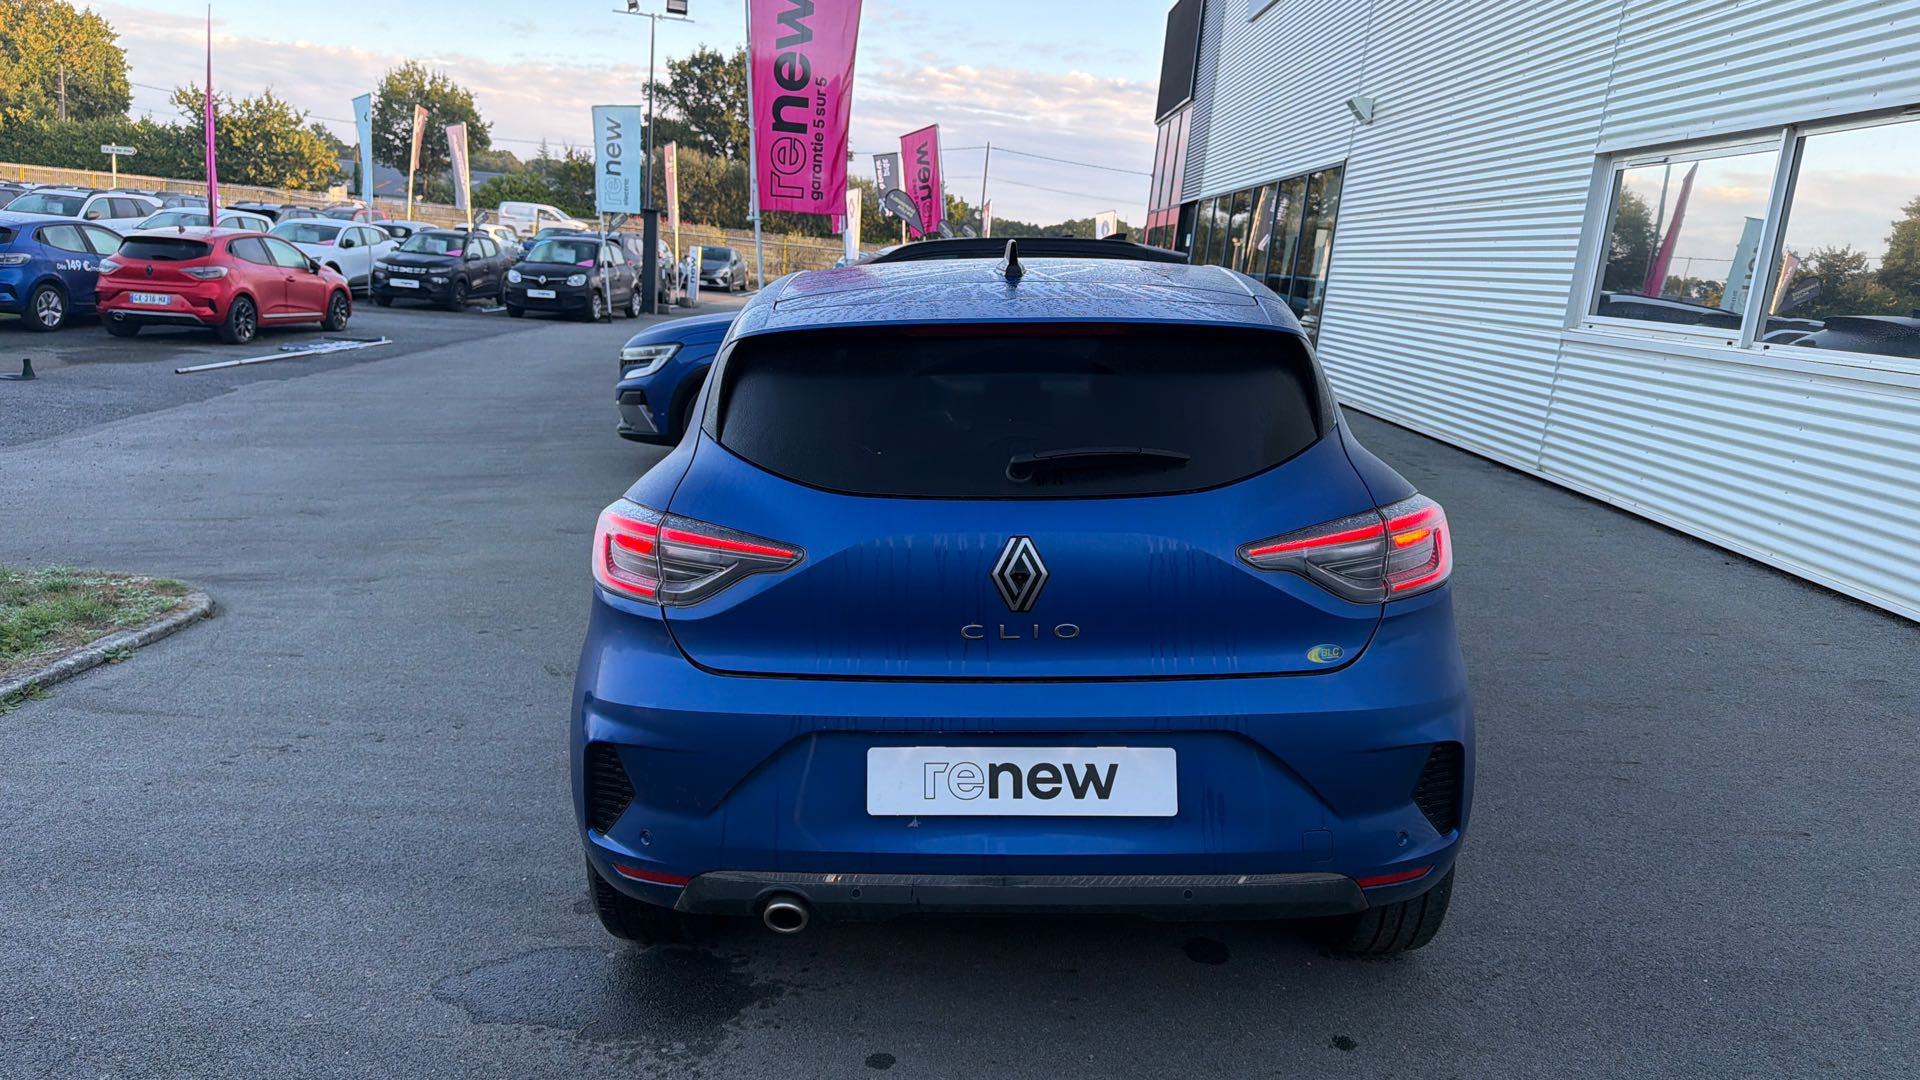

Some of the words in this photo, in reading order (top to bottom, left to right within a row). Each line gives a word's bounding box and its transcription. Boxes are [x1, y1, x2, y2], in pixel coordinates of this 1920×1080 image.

[816, 77, 828, 87] 5
[769, 0, 815, 199] renew
[816, 90, 827, 116] sur
[813, 119, 825, 129] 5
[604, 116, 622, 205] renew
[811, 132, 824, 201] garantie
[65, 259, 82, 271] 149
[960, 623, 1080, 639] CLIO
[923, 761, 1119, 800] renew
